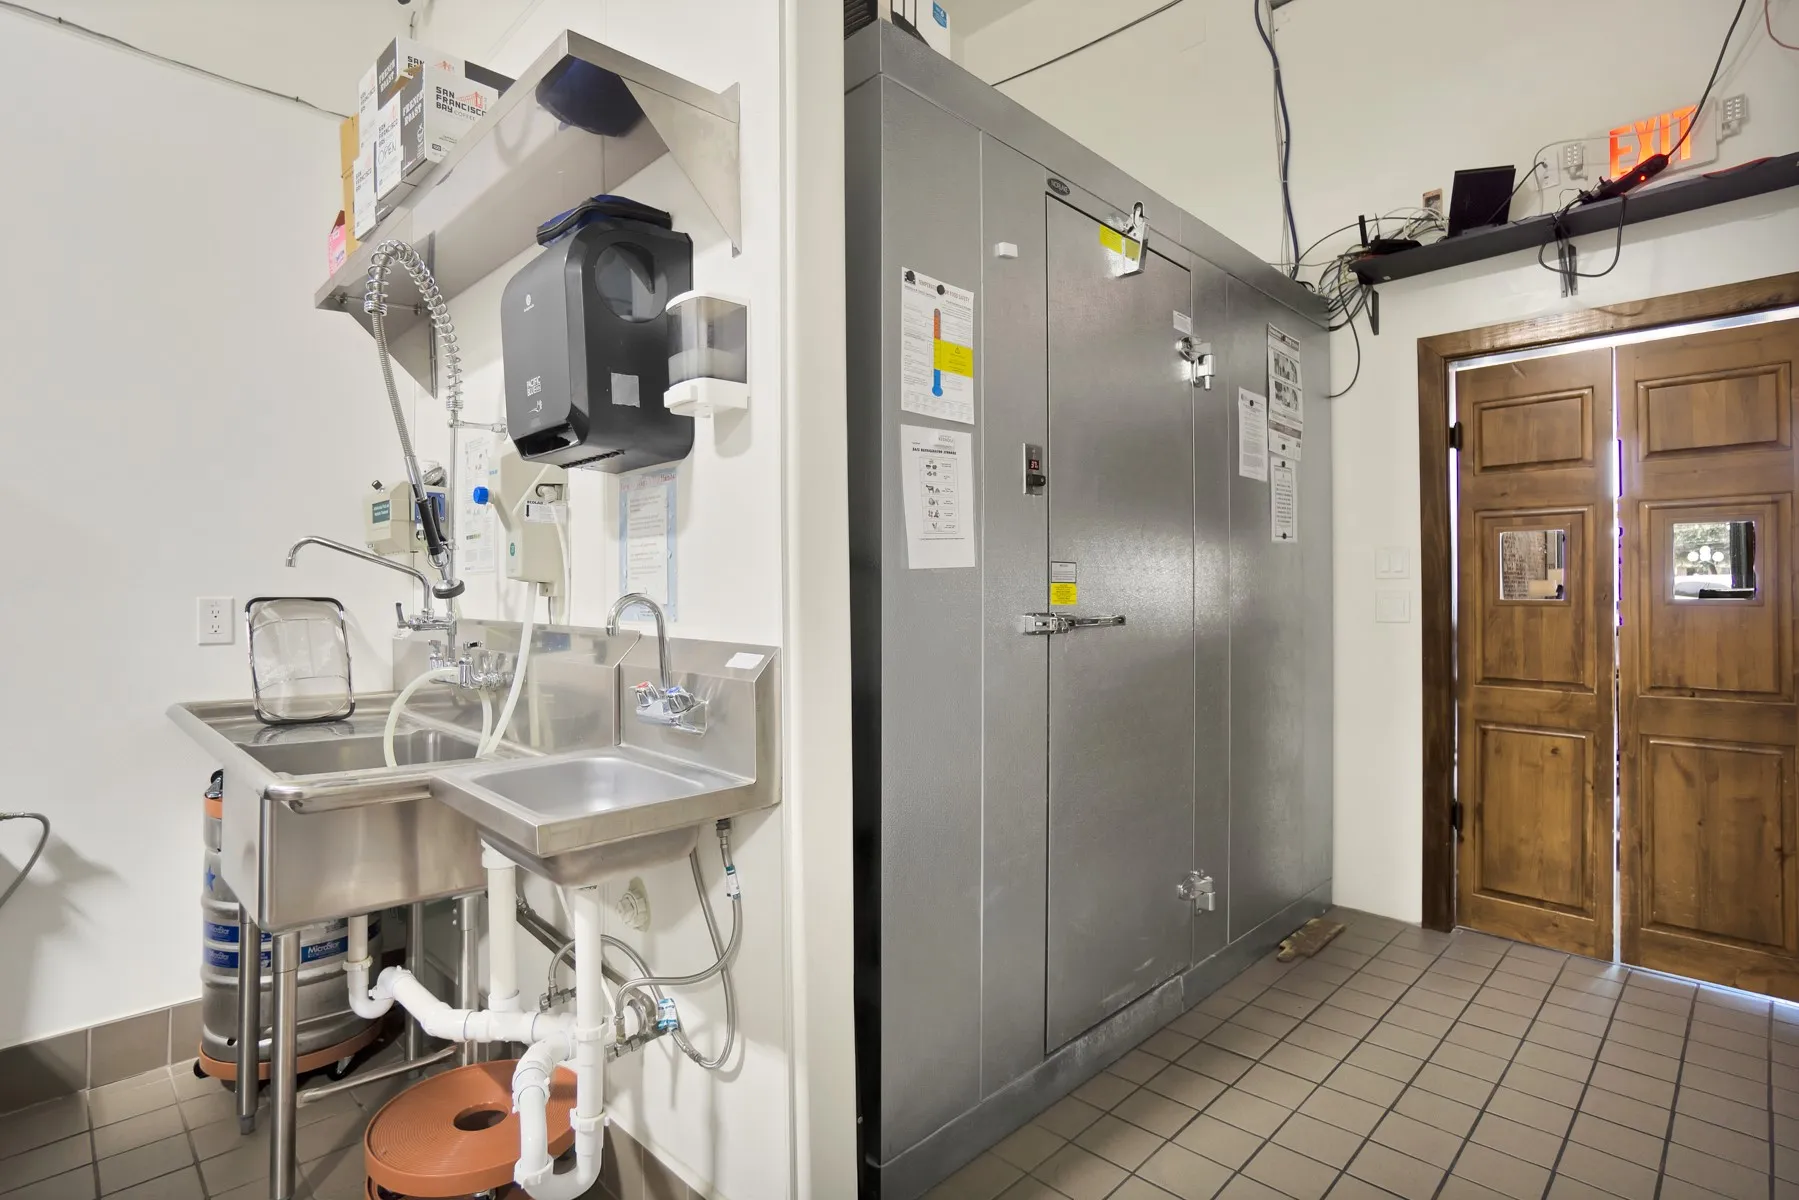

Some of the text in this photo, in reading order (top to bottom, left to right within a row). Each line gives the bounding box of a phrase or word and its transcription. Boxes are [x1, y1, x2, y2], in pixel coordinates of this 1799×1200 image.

[436, 86, 455, 99] SAN
[404, 103, 422, 127] ROAST
[436, 102, 476, 121] BAY COFFEE
[1609, 103, 1699, 179] EXIT
[378, 139, 397, 165] OPEN
[307, 941, 341, 954] MicroStar
